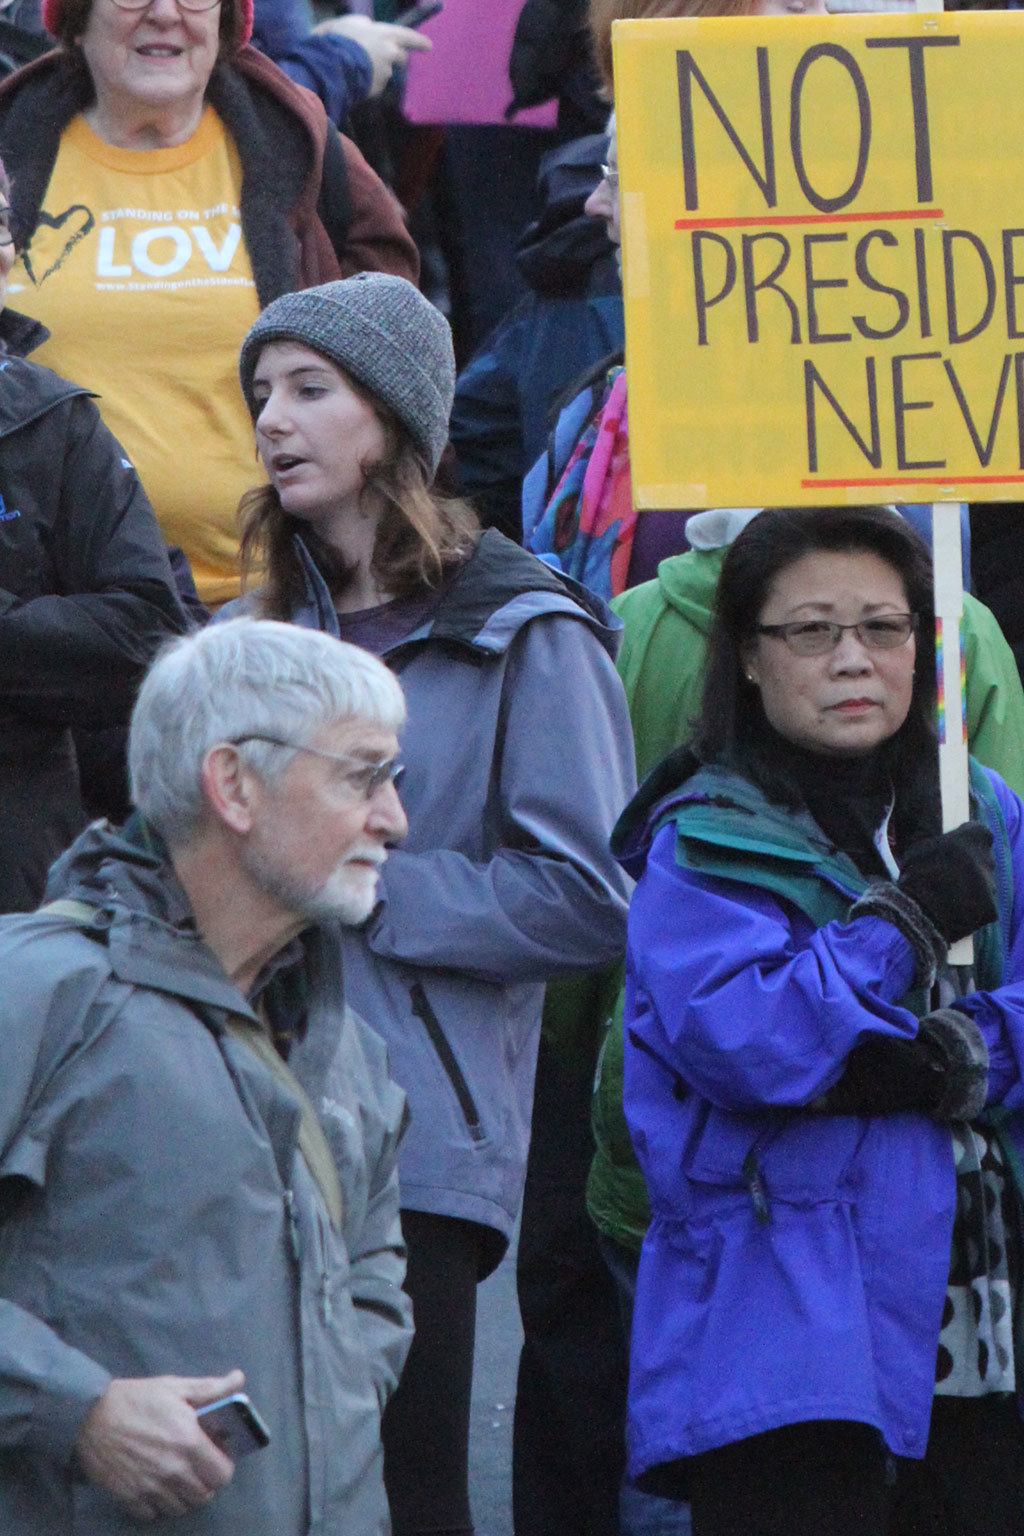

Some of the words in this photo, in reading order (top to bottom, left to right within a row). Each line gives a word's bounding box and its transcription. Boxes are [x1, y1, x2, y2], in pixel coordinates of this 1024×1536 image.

[675, 35, 961, 214] NOT
[102, 207, 173, 223] STANDING
[176, 209, 200, 220] ON
[204, 202, 229, 220] THE
[96, 222, 242, 278] LOV
